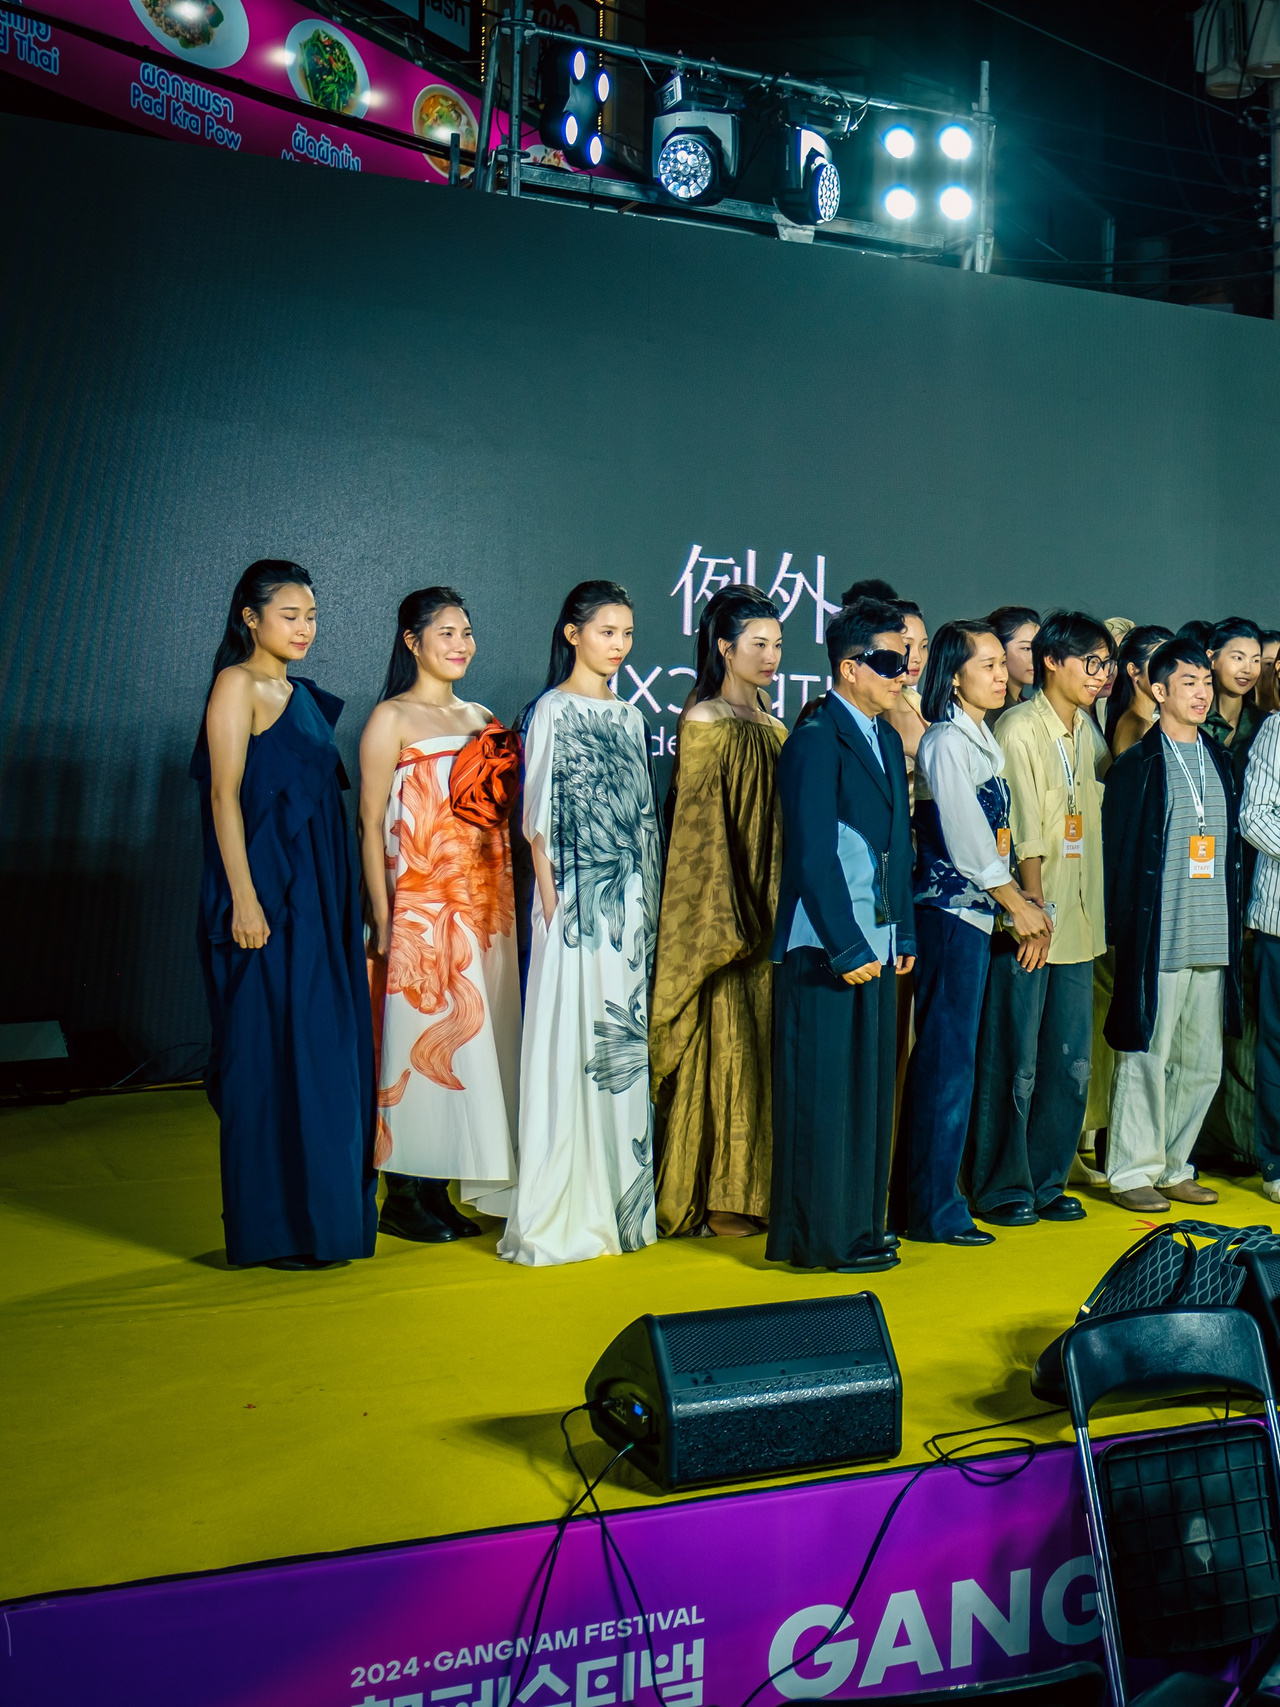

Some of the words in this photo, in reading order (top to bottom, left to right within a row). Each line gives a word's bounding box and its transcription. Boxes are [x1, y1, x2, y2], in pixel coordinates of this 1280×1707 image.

[13, 31, 60, 76] Thai
[130, 82, 166, 120] Pad
[170, 99, 201, 135] Kra
[205, 114, 242, 150] Pow
[671, 544, 842, 644] 例外
[584, 1605, 705, 1646] FESTIVAL
